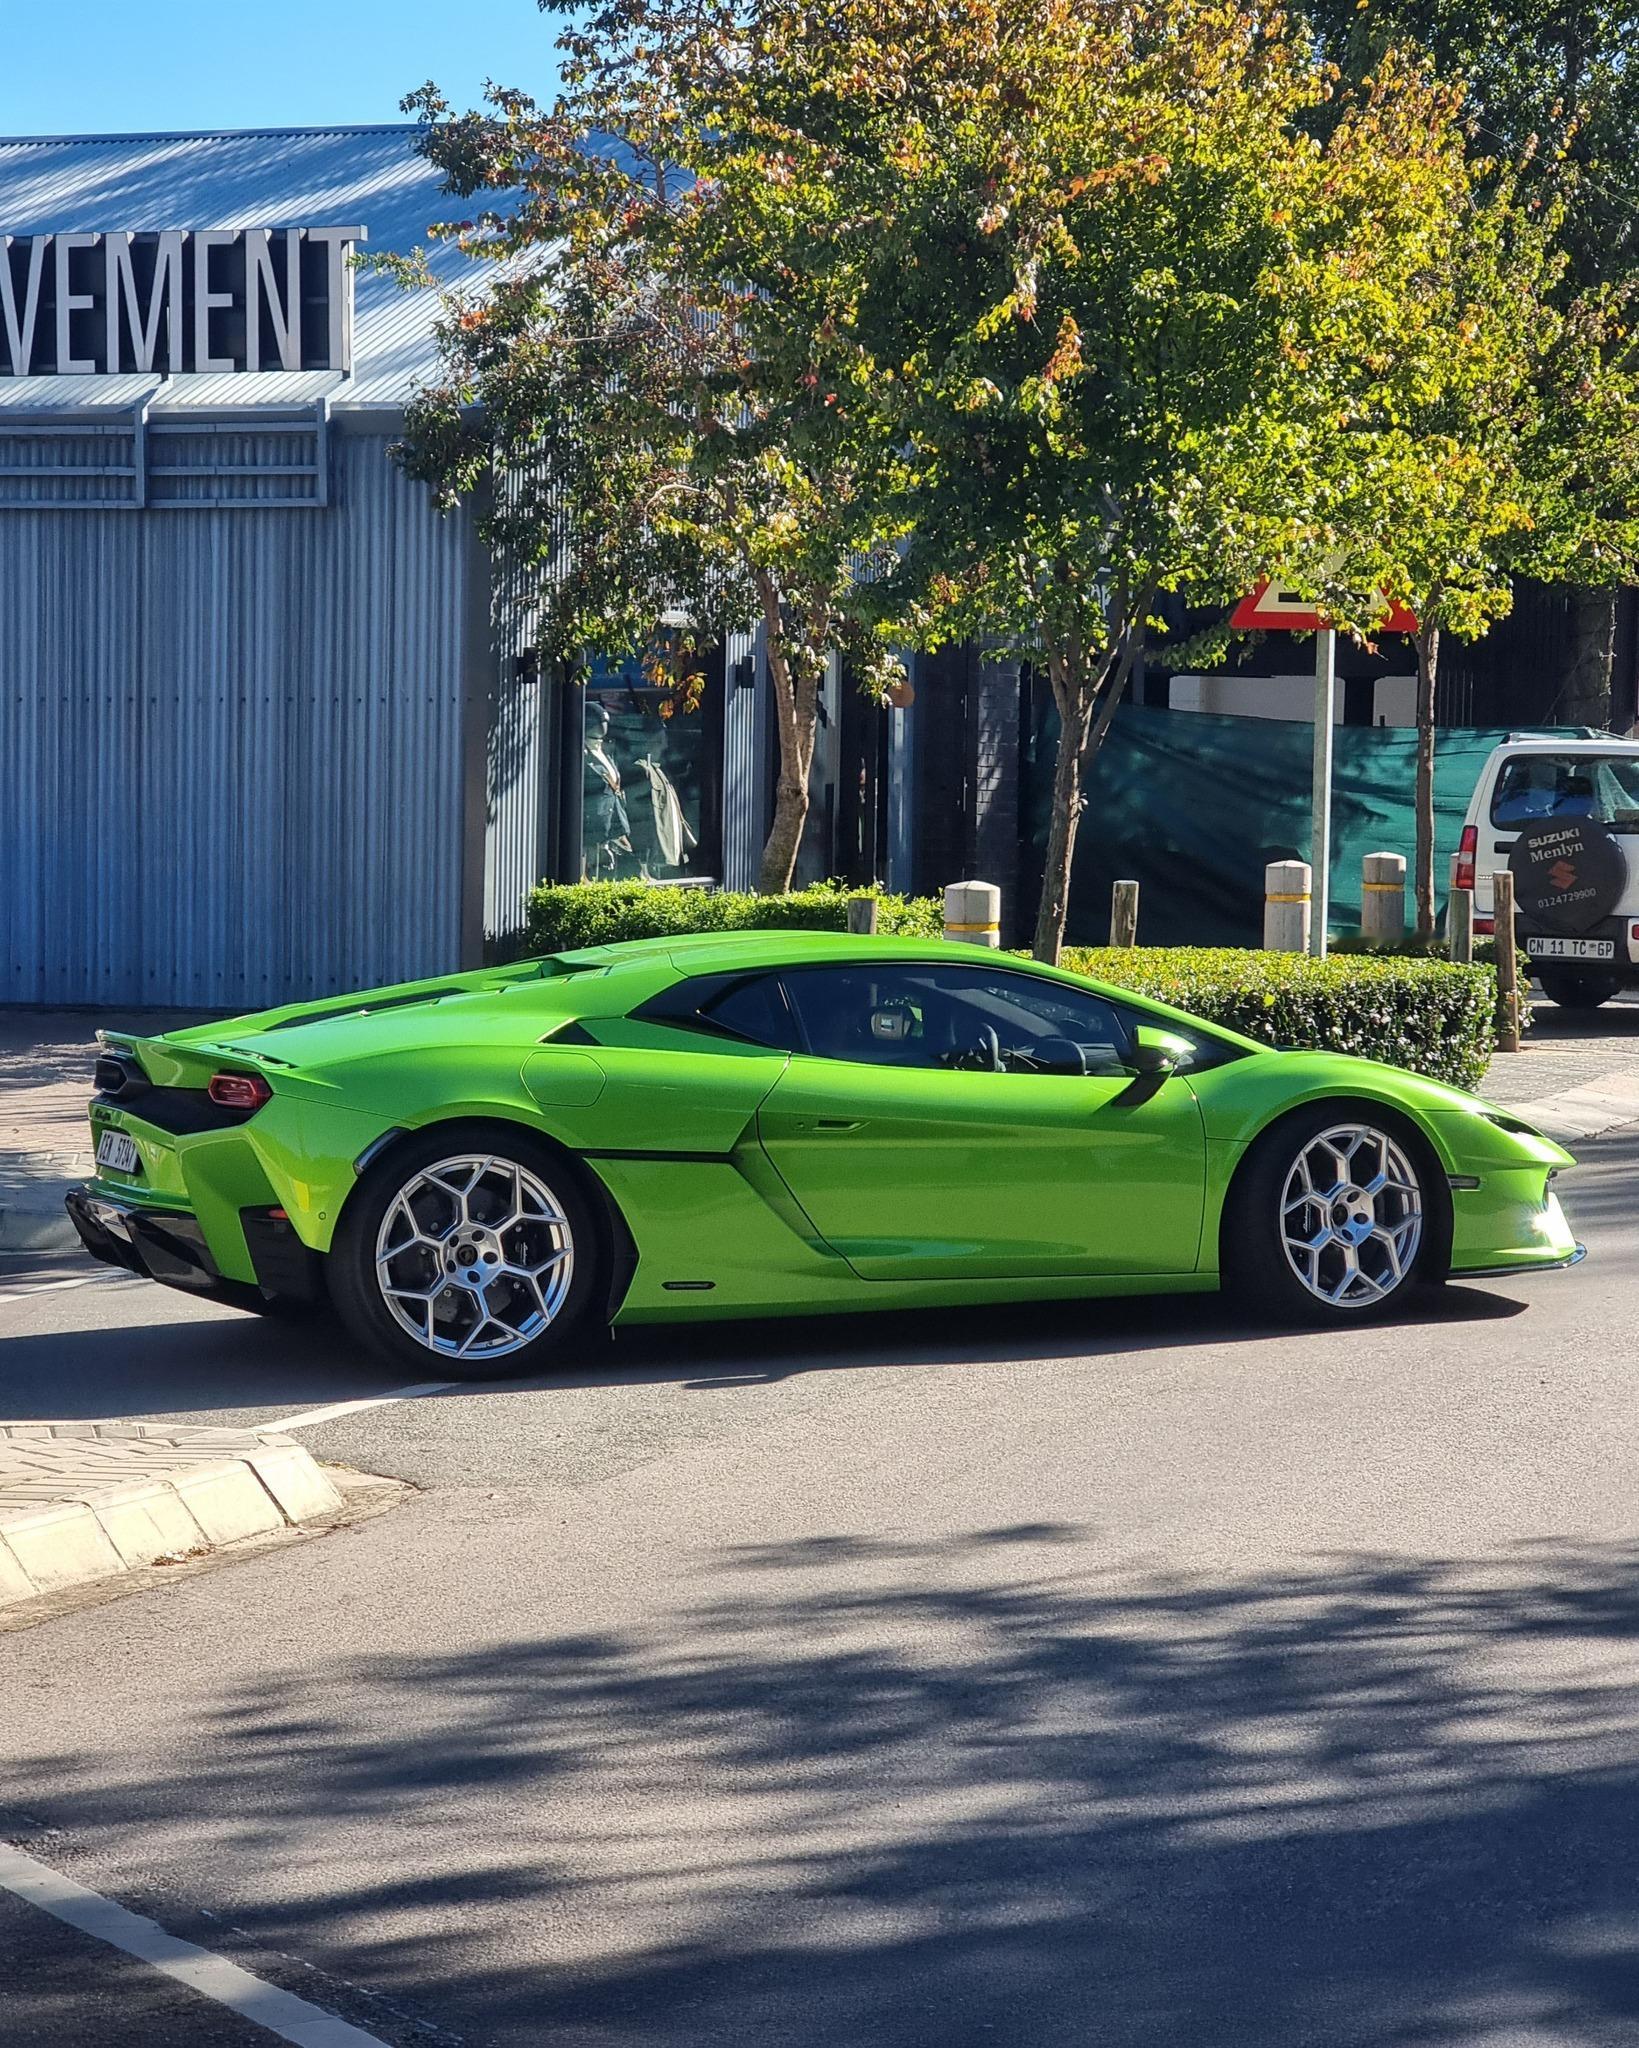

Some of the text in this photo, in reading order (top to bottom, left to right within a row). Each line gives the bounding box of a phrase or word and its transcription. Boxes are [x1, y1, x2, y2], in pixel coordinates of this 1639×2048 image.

[0, 225, 367, 376] VEMENT
[1528, 828, 1580, 848] SUZUKI
[1529, 842, 1584, 863] Menlyn
[1529, 939, 1544, 954] CN
[1550, 940, 1564, 955] 11
[1572, 941, 1586, 955] TC
